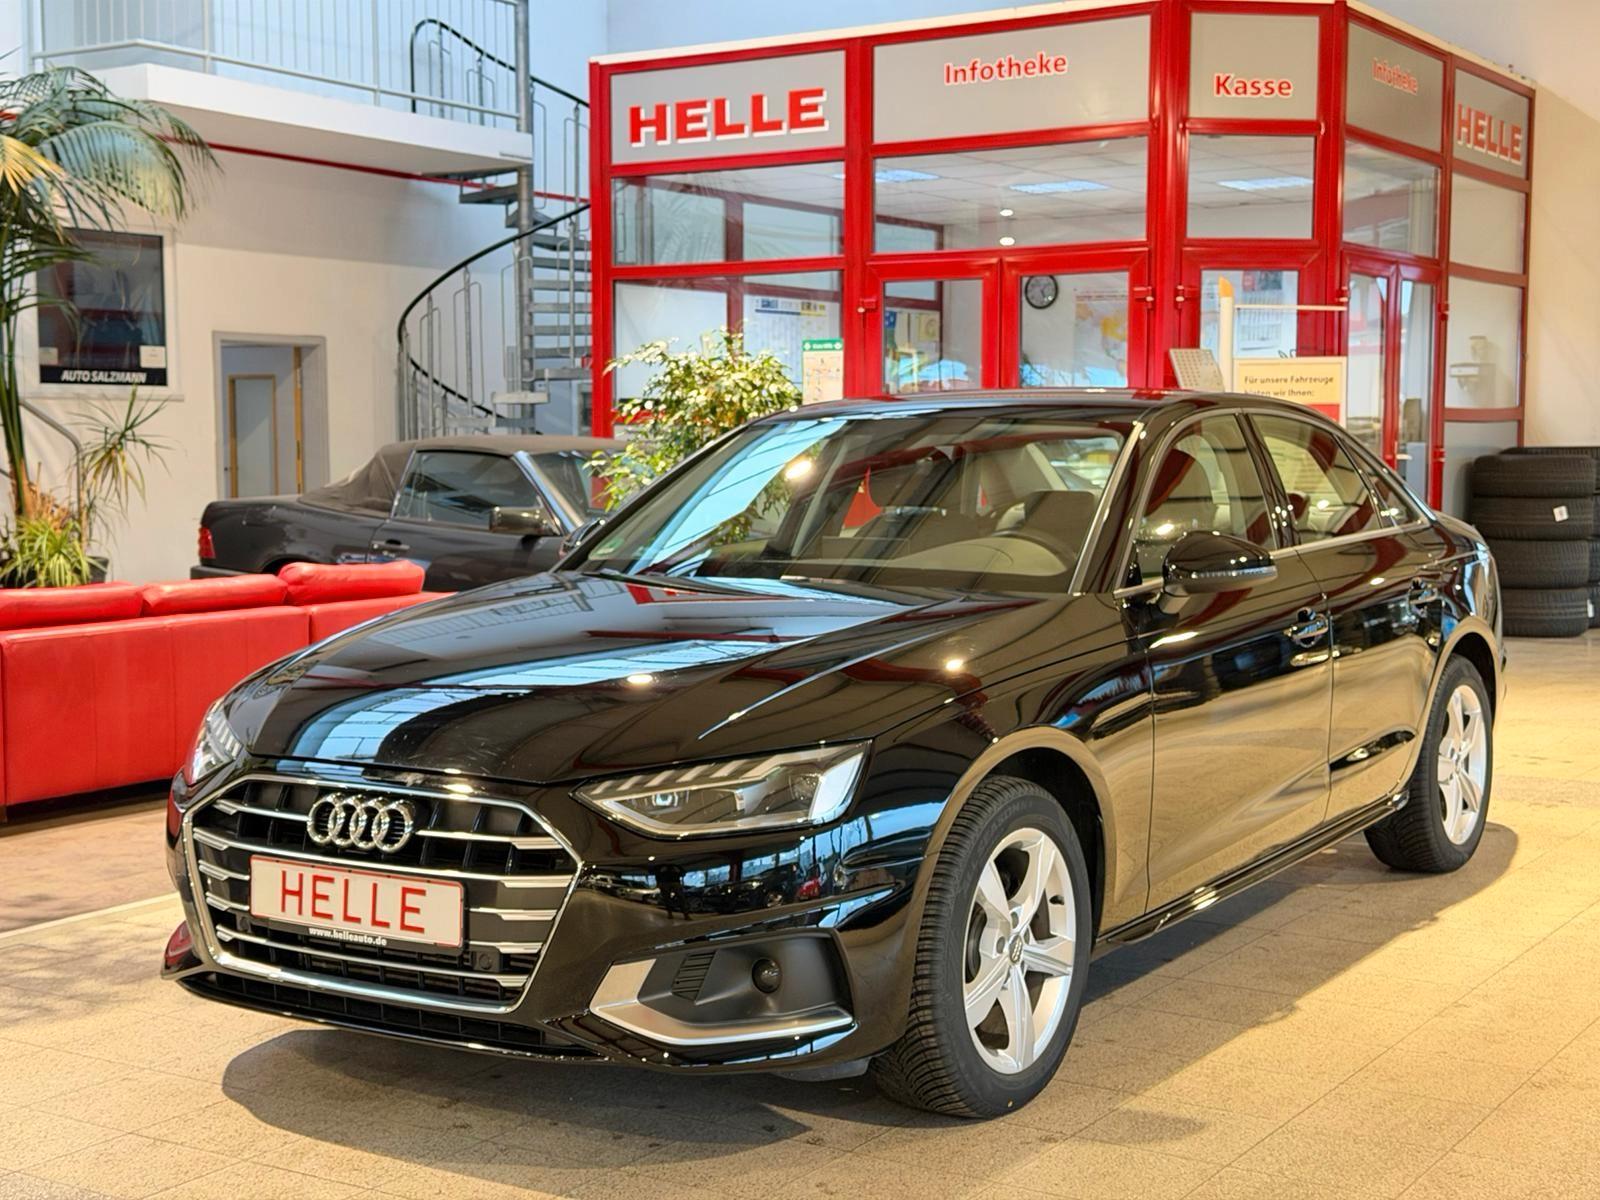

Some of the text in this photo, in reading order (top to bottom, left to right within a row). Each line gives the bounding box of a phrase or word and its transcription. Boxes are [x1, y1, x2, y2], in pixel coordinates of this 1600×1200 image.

[944, 52, 1068, 86] Infotheke
[1213, 73, 1294, 98] Kasse
[629, 88, 829, 147] HELLE
[1457, 103, 1522, 165] HELLE
[61, 369, 147, 384] AUTO SALZMANN
[1244, 375, 1334, 386] Für unsere Fahrzeuge
[1273, 389, 1287, 397] wir
[281, 870, 426, 934] HELLE
[308, 928, 387, 946] www.helleauto.de
